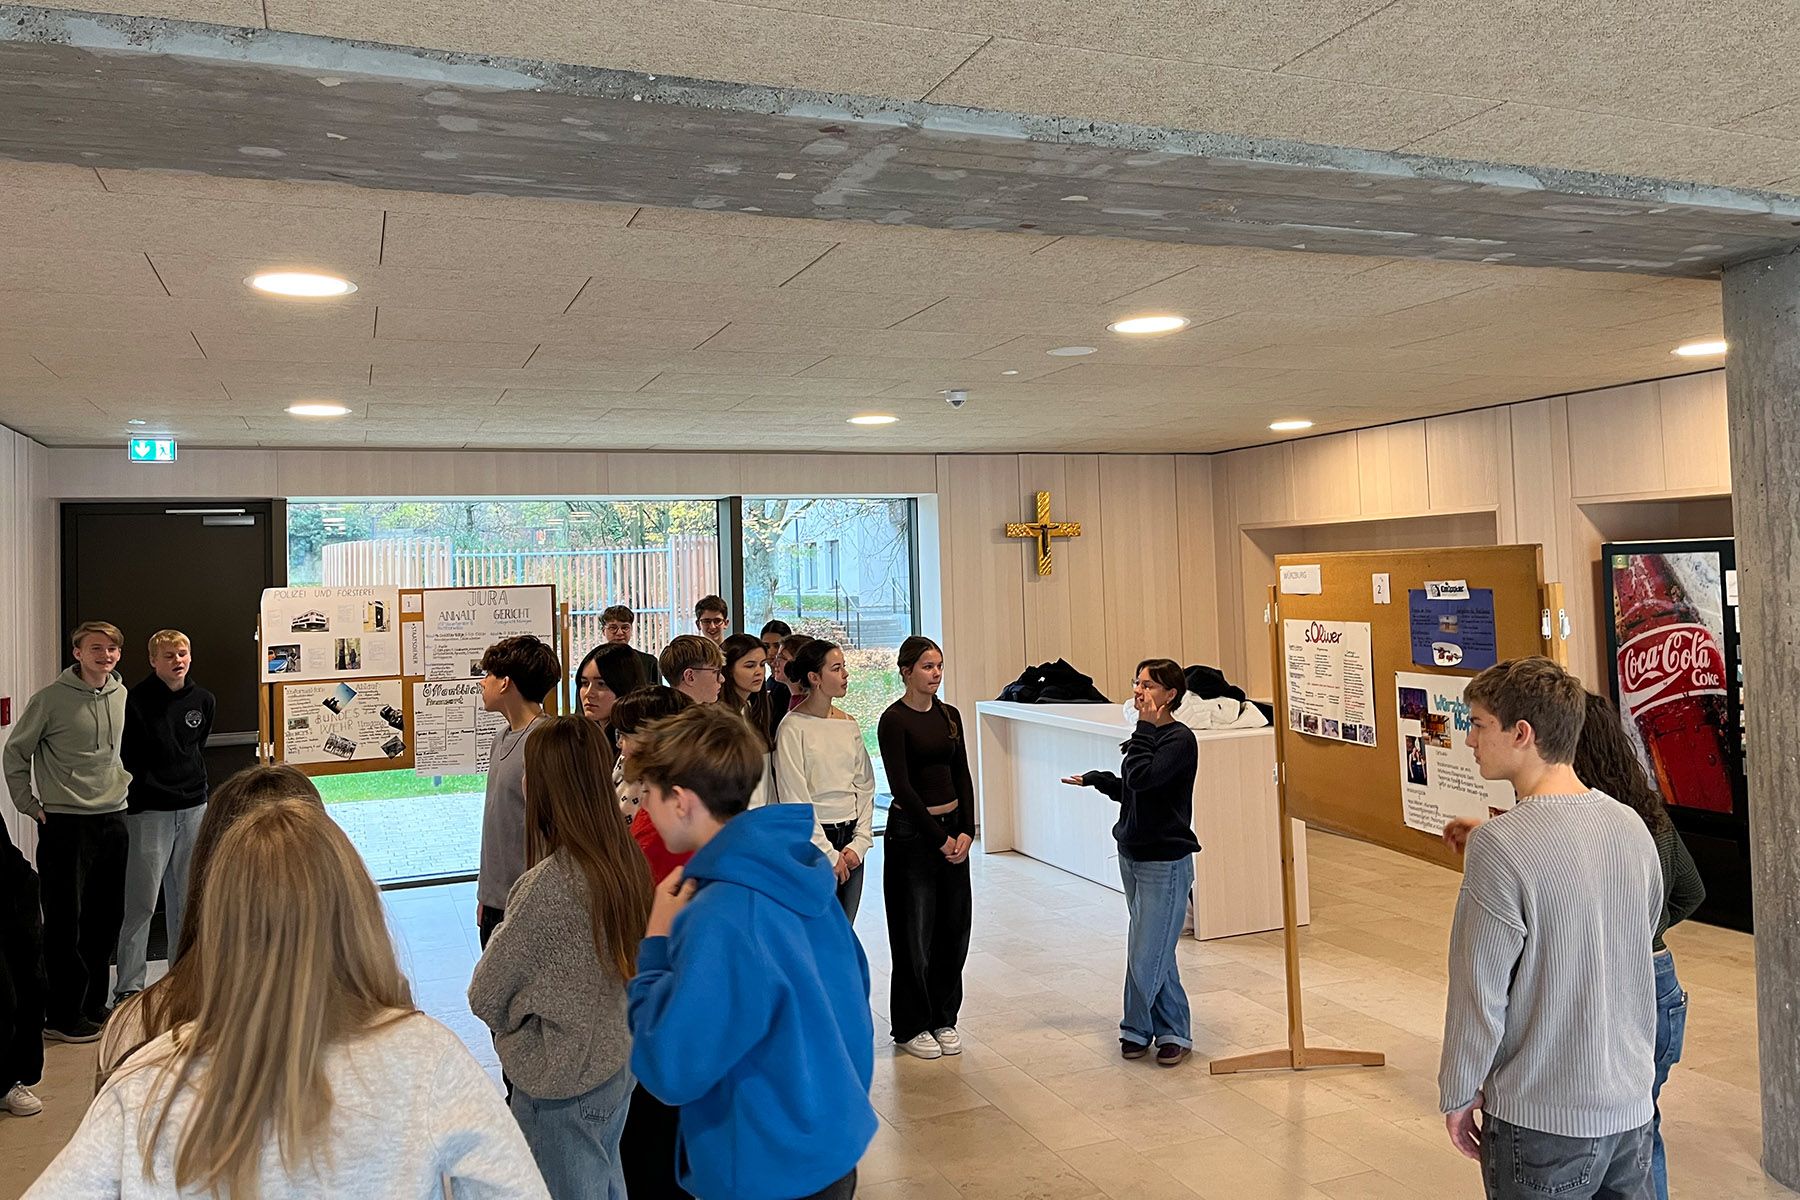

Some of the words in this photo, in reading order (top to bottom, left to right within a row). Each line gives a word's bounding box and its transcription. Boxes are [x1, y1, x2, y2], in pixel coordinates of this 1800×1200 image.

[274, 590, 306, 599] POLIZEI
[314, 589, 332, 598] UND
[1377, 584, 1382, 594] 2
[467, 589, 509, 606] JURA
[439, 609, 476, 621] ANWALT
[493, 608, 531, 620] GERICHT
[1624, 630, 1713, 690] Coca-Cola
[1691, 668, 1720, 686] Coke
[320, 720, 353, 734] WEHR
